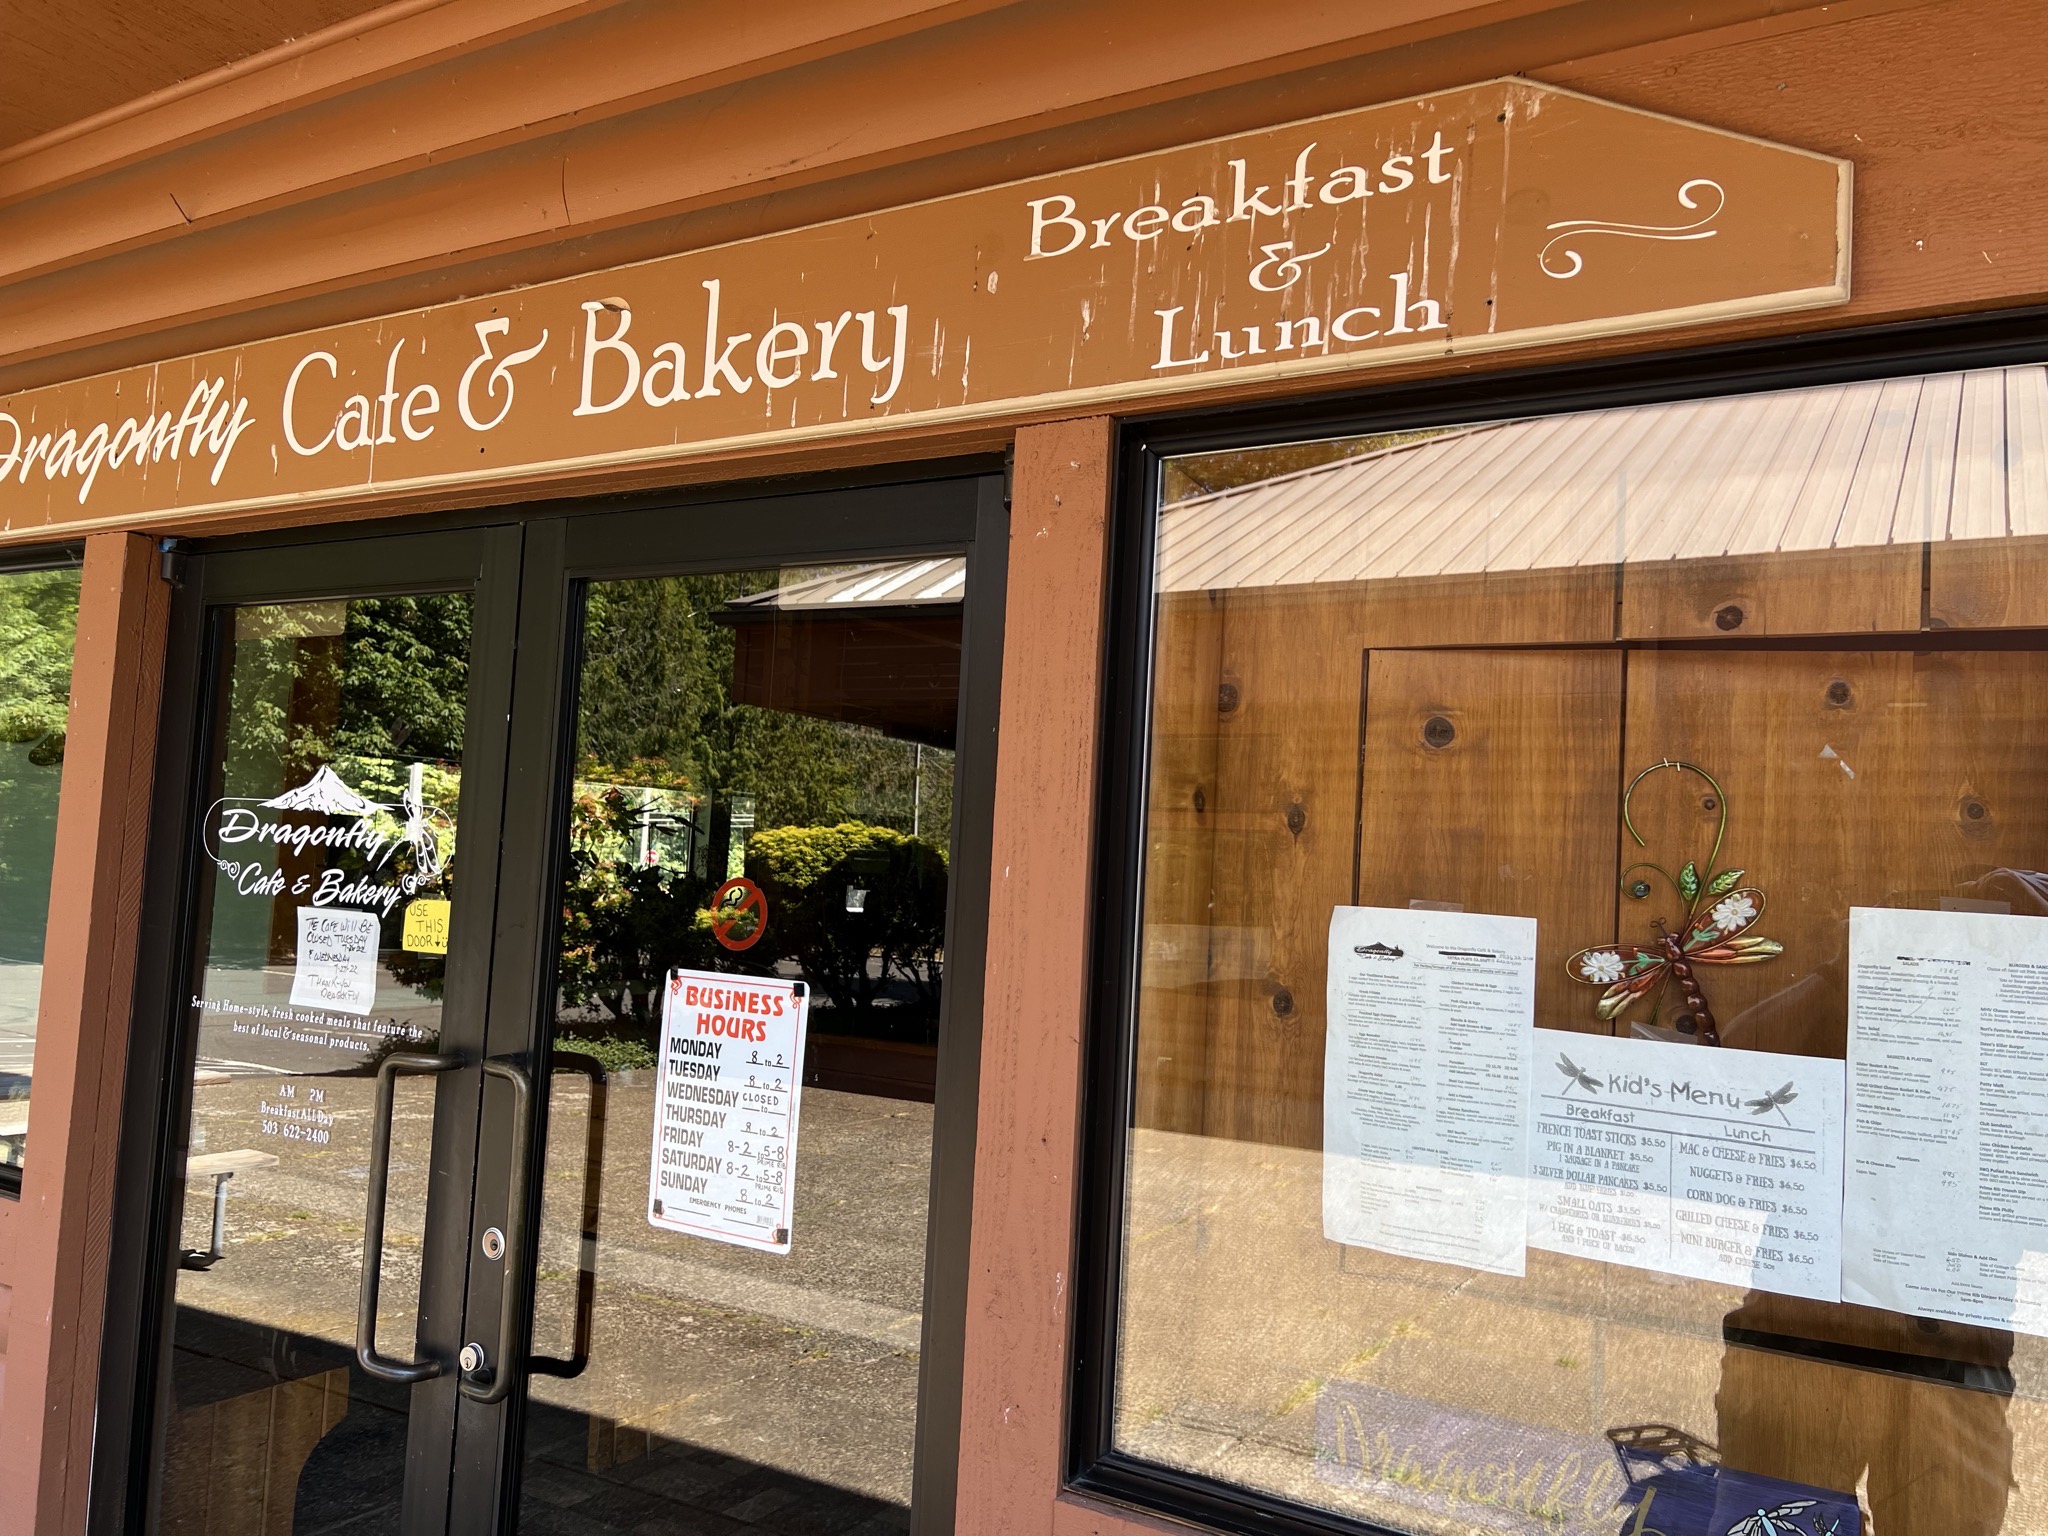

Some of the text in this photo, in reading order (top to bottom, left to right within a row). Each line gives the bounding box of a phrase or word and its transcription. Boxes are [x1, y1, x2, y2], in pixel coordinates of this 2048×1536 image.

[1022, 130, 1454, 262] Breakfast
[1248, 240, 1332, 292] &
[1150, 271, 1449, 370] Lunch
[457, 317, 548, 431] &
[572, 278, 909, 417] Bakery
[218, 808, 391, 861] Dragonfly
[238, 862, 402, 918] Cafe & Bakery
[409, 903, 428, 917] USE
[415, 918, 443, 933] THIS
[333, 934, 368, 946] TUESDAY
[406, 934, 433, 947] DOOR
[314, 952, 350, 964] WEDNESDAY
[191, 995, 423, 1038] Serving Home-style, fresh cooked meals that feature the
[696, 1012, 766, 1042] HOURS
[232, 1020, 249, 1033] best
[251, 1024, 261, 1035] of
[261, 1024, 281, 1038] local
[282, 1026, 293, 1040] &
[291, 1032, 328, 1045] seasonal
[670, 1036, 784, 1067] MONDAY 8 to 2
[669, 1058, 783, 1090] TUESDAY 8 to 2
[279, 1084, 324, 1103] AM PM
[667, 1081, 779, 1108] WEDNESDAY CLOSED
[1607, 1073, 1740, 1110] Kid's Menu
[261, 1101, 300, 1118] Breakfast
[317, 1110, 334, 1127] Day
[665, 1103, 778, 1137] THURSDAY 8 to 2
[761, 1105, 768, 1114] to
[1566, 1103, 1636, 1123] Breakfast
[262, 1120, 329, 1144] 503 622-2400
[663, 1125, 704, 1148] FRIDAY
[757, 1152, 765, 1160] to
[1536, 1121, 1666, 1148] FRENCH TOAST STICKS $5.50
[1724, 1125, 1771, 1142] Lunch
[662, 1148, 723, 1175] SATURDAY
[755, 1174, 763, 1182] to
[1546, 1140, 1654, 1163] PIG IN A BLANKET $5.50
[1679, 1141, 1816, 1170] MAC & CHEESE & FRIES $6.50
[660, 1170, 774, 1207] SUNDAY 8 to 2
[755, 1182, 784, 1195] PRIME RIB
[1533, 1165, 1668, 1193] 3 SILVER DOLLAR PANCAKES $5.50
[1689, 1166, 1805, 1191] NUGGETS & FRIES $6.50
[688, 1196, 747, 1215] EMERGENCY PHONES
[1557, 1195, 1586, 1209] SMALL
[1588, 1200, 1613, 1213] OATS
[1686, 1188, 1808, 1215] CORN DOG & FRIES $6.50
[1558, 1221, 1575, 1235] EGG
[1576, 1226, 1583, 1236] &
[1585, 1227, 1617, 1242] TOAST
[1675, 1209, 1712, 1225] GRILLED
[1715, 1215, 1750, 1232] CHEESE
[1752, 1223, 1759, 1233] &
[1762, 1223, 1789, 1239] FRIES
[1680, 1231, 1814, 1265] MINI BURGER & FRIES $6.50
